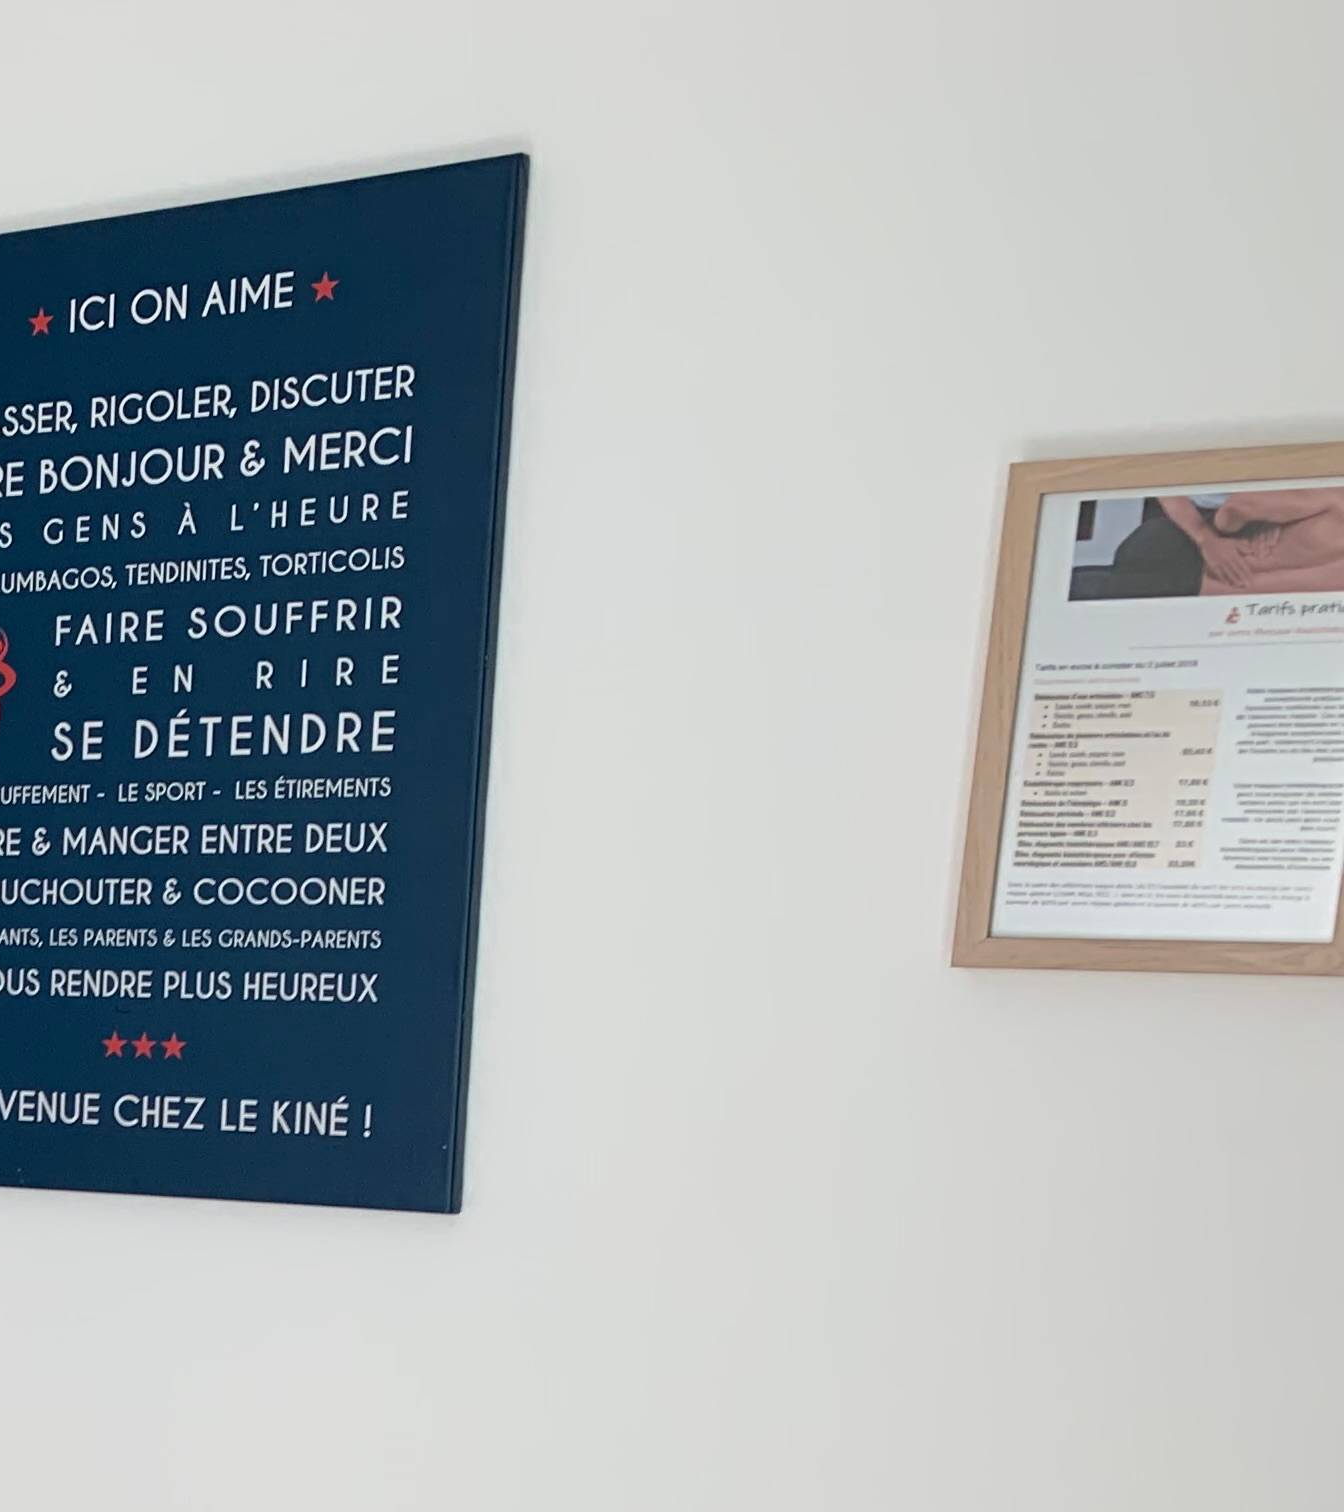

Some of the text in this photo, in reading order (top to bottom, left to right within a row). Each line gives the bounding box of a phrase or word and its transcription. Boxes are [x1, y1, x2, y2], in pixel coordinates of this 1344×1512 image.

[69, 271, 295, 333] ICI ON AIME
[90, 384, 238, 429] RIGOLER,
[250, 364, 415, 413] DISCUTER
[39, 443, 225, 495] BONJOUR
[239, 439, 266, 477] &
[283, 425, 413, 474] MERCI
[43, 511, 146, 545] GENS
[177, 502, 197, 535] À
[230, 490, 409, 531] L'HEURE
[125, 556, 251, 586] TENDINITES,
[259, 545, 405, 577] TORTICOLIS
[55, 596, 402, 647] FAIRE SOUFFRIR
[1245, 601, 1296, 616] Tarifs
[53, 654, 400, 698] & EN RIRE
[51, 708, 396, 762] SE DÉTENDRE
[118, 783, 139, 802] LE
[144, 781, 207, 802] SPORT
[235, 779, 268, 800] LES
[274, 775, 392, 799] ÉTIREMENTS
[31, 827, 51, 856] &
[62, 825, 190, 856] MANGER
[201, 823, 293, 854] ENTRE
[305, 822, 388, 853] DEUX
[162, 878, 182, 905] &
[193, 877, 386, 905] COCOONER
[49, 928, 78, 947] LES
[83, 928, 158, 947] PARENTS
[162, 928, 176, 947] &
[182, 929, 212, 948] LES
[218, 929, 382, 949] GRANDS-PARENTS
[50, 969, 153, 998] RENDRE
[163, 970, 232, 1000] PLUS
[243, 971, 378, 1003] HEUREUX
[113, 1094, 206, 1130] CHEZ
[220, 1098, 258, 1133] LE
[272, 1095, 349, 1137] KINÉ
[363, 1104, 372, 1138] !
